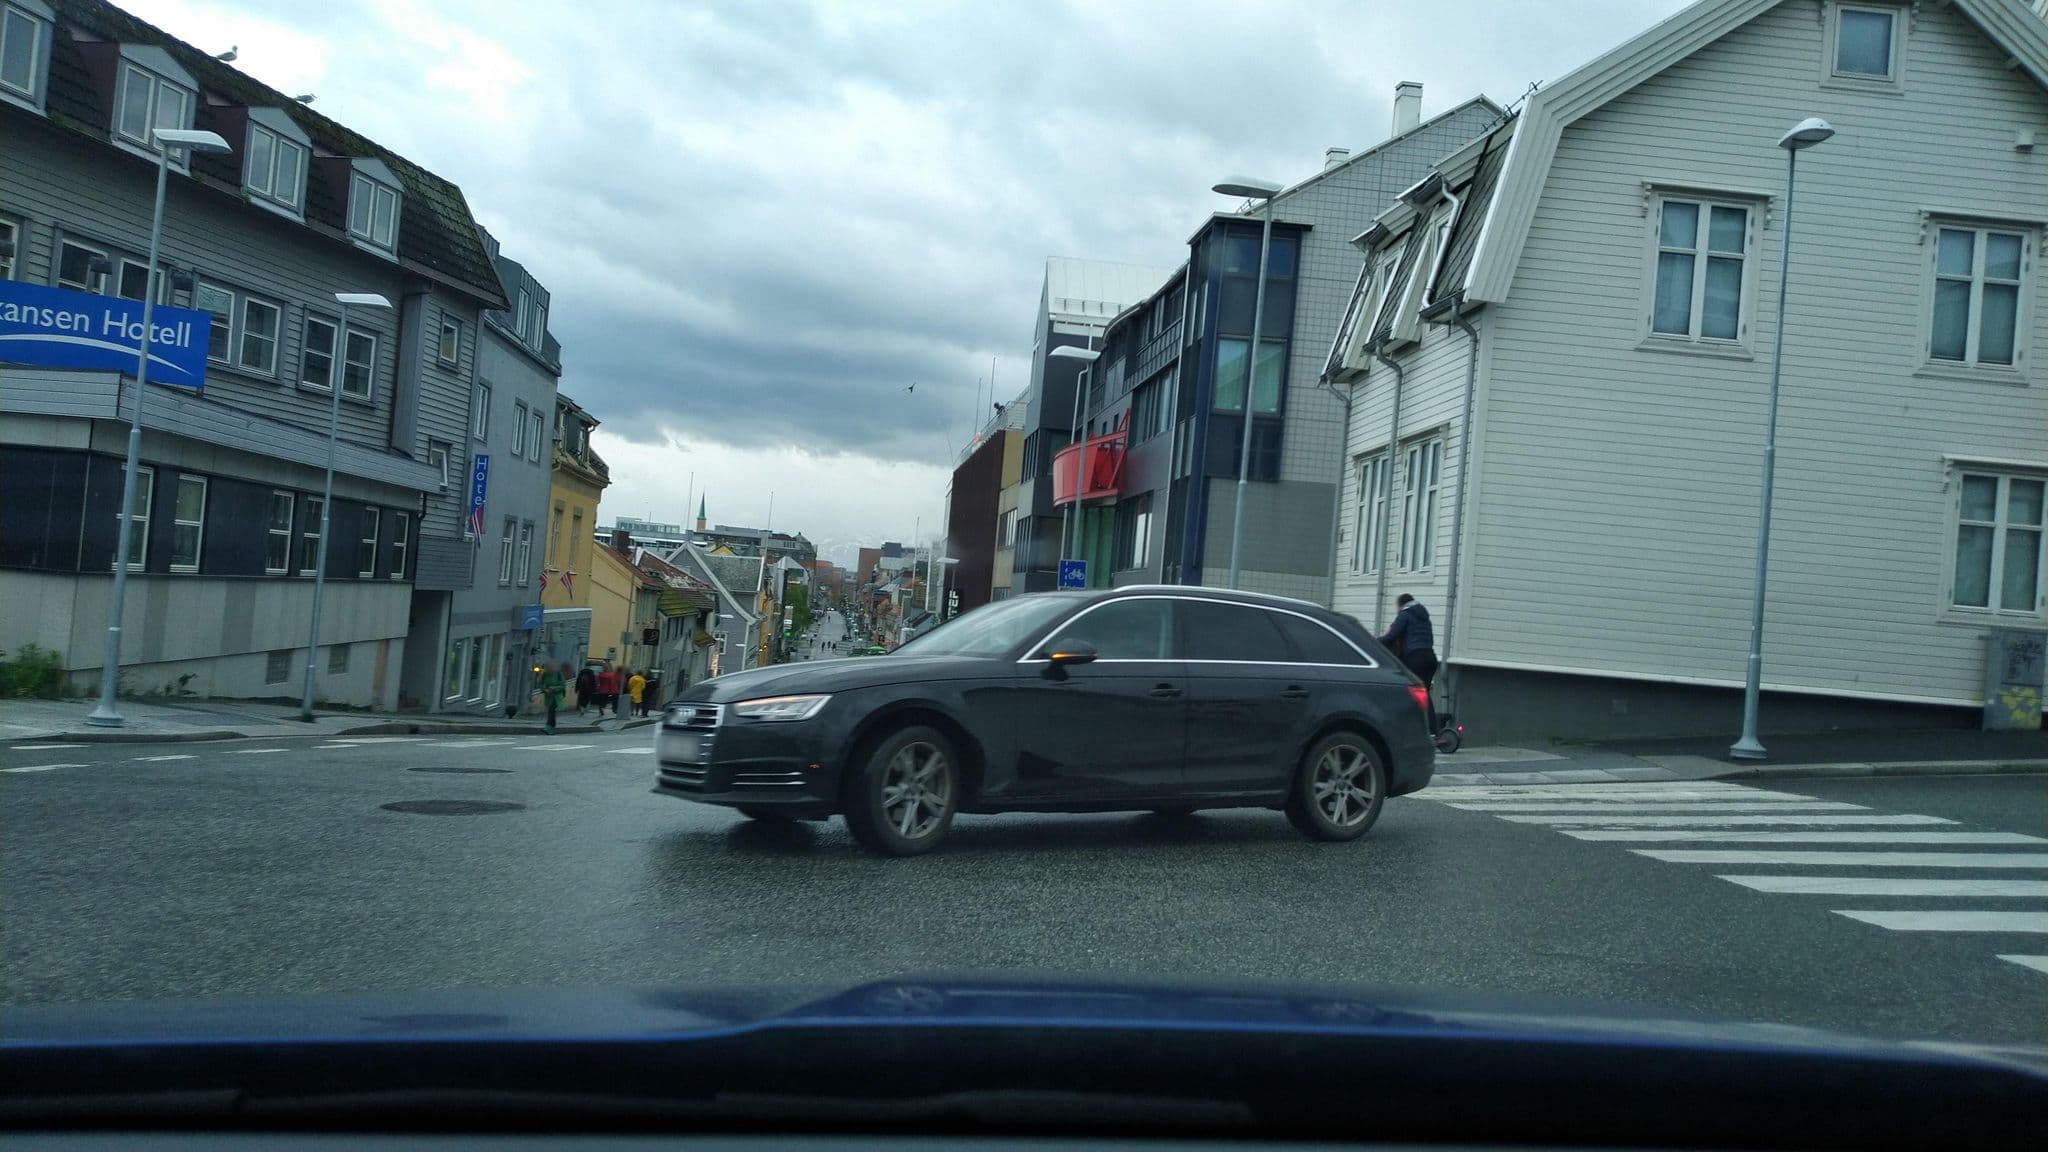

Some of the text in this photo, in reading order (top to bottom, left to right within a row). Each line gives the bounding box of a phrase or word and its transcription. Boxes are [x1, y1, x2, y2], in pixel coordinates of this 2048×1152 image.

[103, 309, 191, 348] Hotell
[474, 457, 488, 506] Hote
[947, 590, 959, 619] TEF
